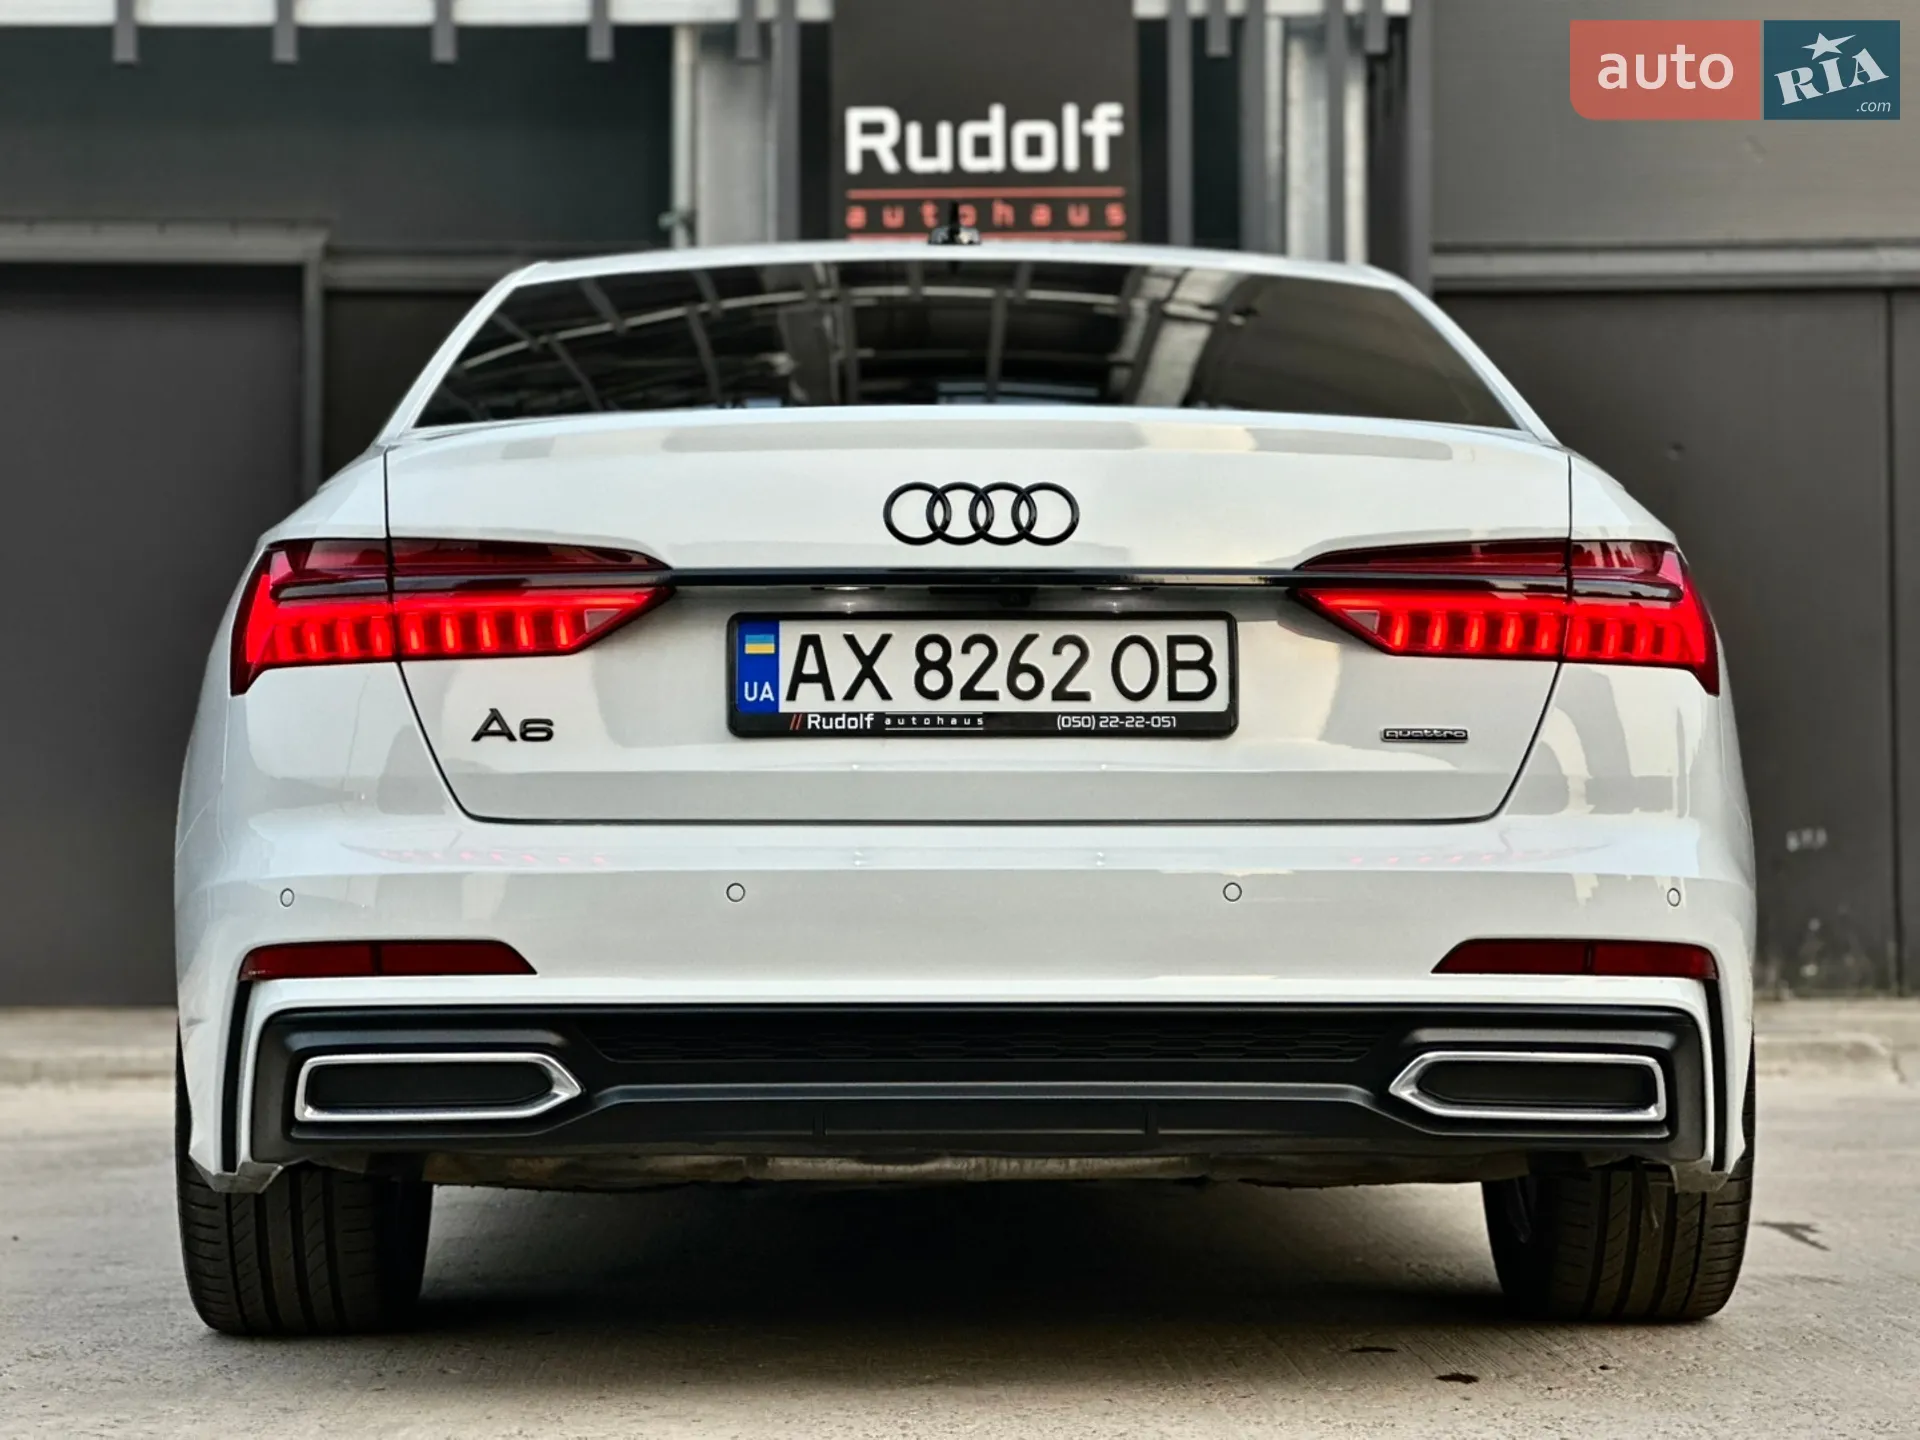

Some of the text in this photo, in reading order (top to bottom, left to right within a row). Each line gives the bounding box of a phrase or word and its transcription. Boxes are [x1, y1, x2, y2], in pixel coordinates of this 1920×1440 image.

[844, 101, 1125, 175] Rudolf
[844, 198, 1127, 229] autohaus
[785, 633, 1218, 701] AX 8262 OB
[743, 681, 775, 702] UA
[470, 707, 555, 742] A6
[807, 713, 984, 730] Rudolf autohaus
[1057, 714, 1177, 730] (050) 22-22-051
[1384, 729, 1467, 740] quattro
